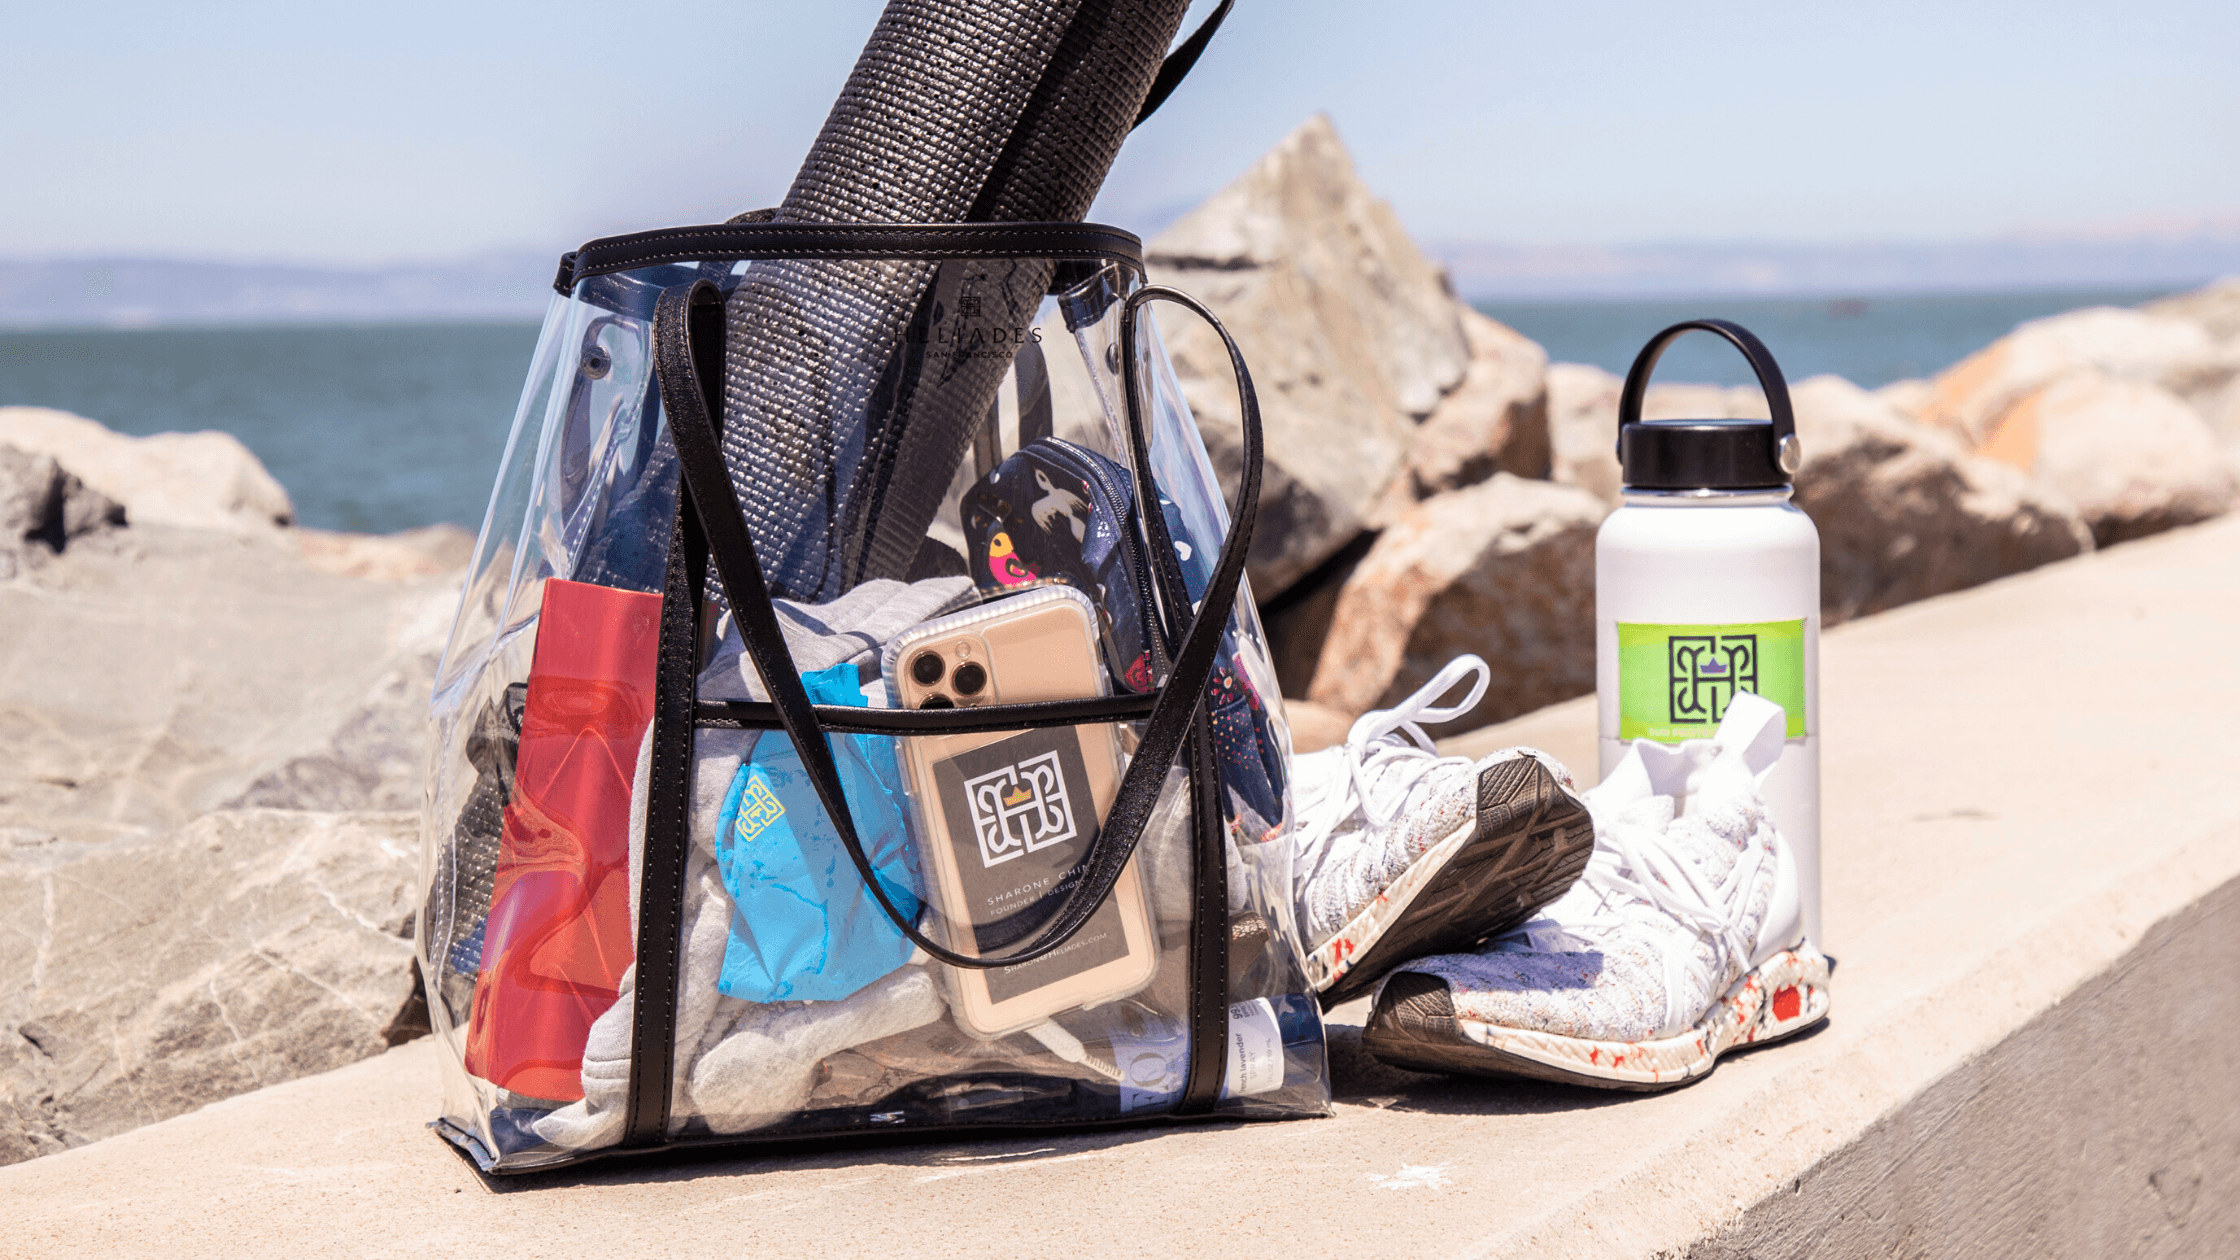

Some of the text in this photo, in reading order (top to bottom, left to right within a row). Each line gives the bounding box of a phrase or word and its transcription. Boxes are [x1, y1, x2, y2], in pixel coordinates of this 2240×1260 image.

[925, 351, 1013, 359] SAN FRANCISCO
[987, 877, 1050, 906] SHARONE
[990, 896, 1035, 916] FOUNDER
